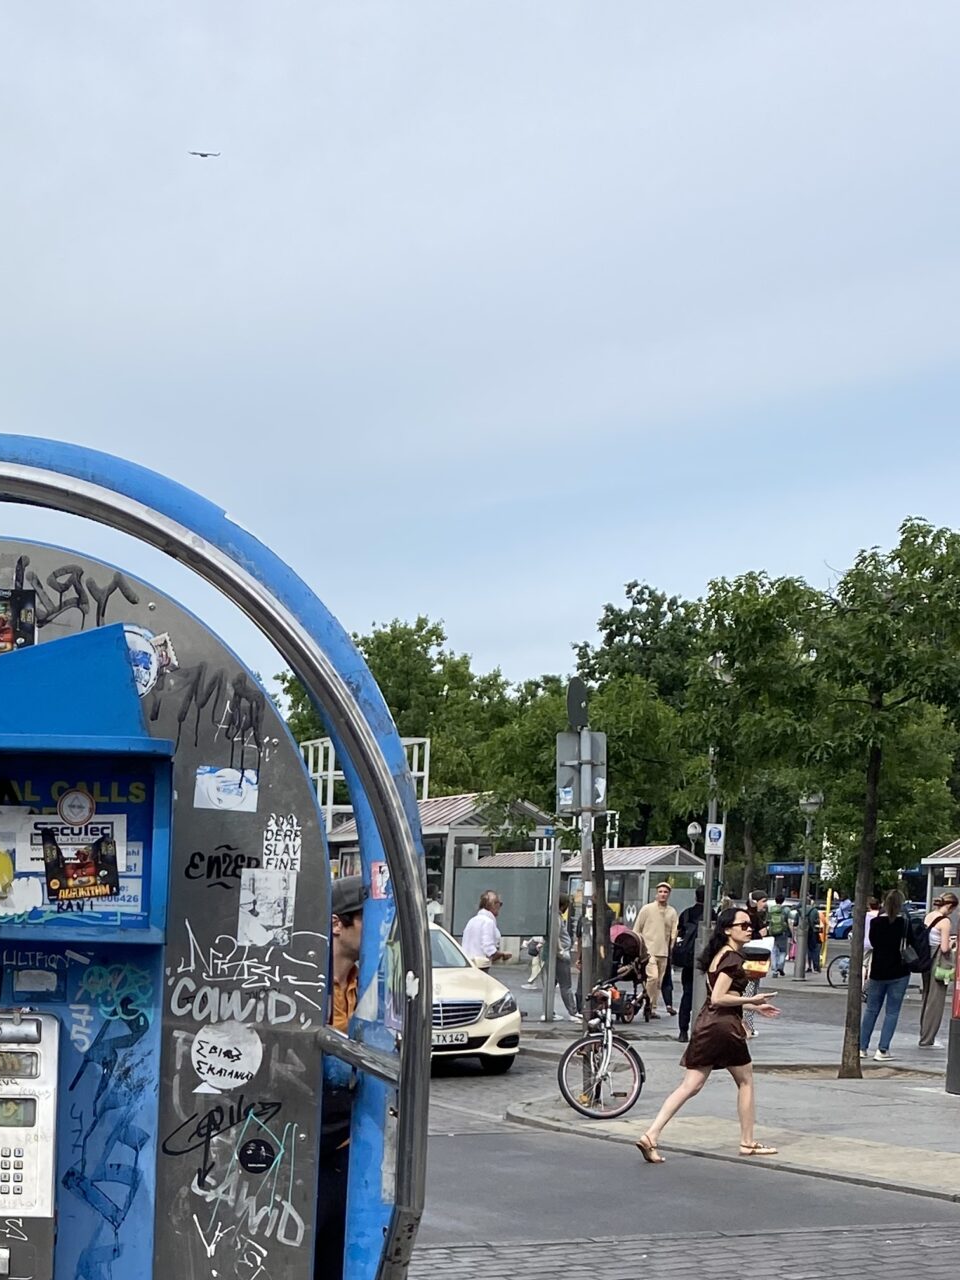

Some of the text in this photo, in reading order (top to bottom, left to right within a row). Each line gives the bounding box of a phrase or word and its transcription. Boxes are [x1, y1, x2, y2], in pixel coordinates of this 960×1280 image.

[264, 843, 302, 857] SLAV
[265, 857, 300, 871] FINE
[449, 1033, 465, 1043] 142
